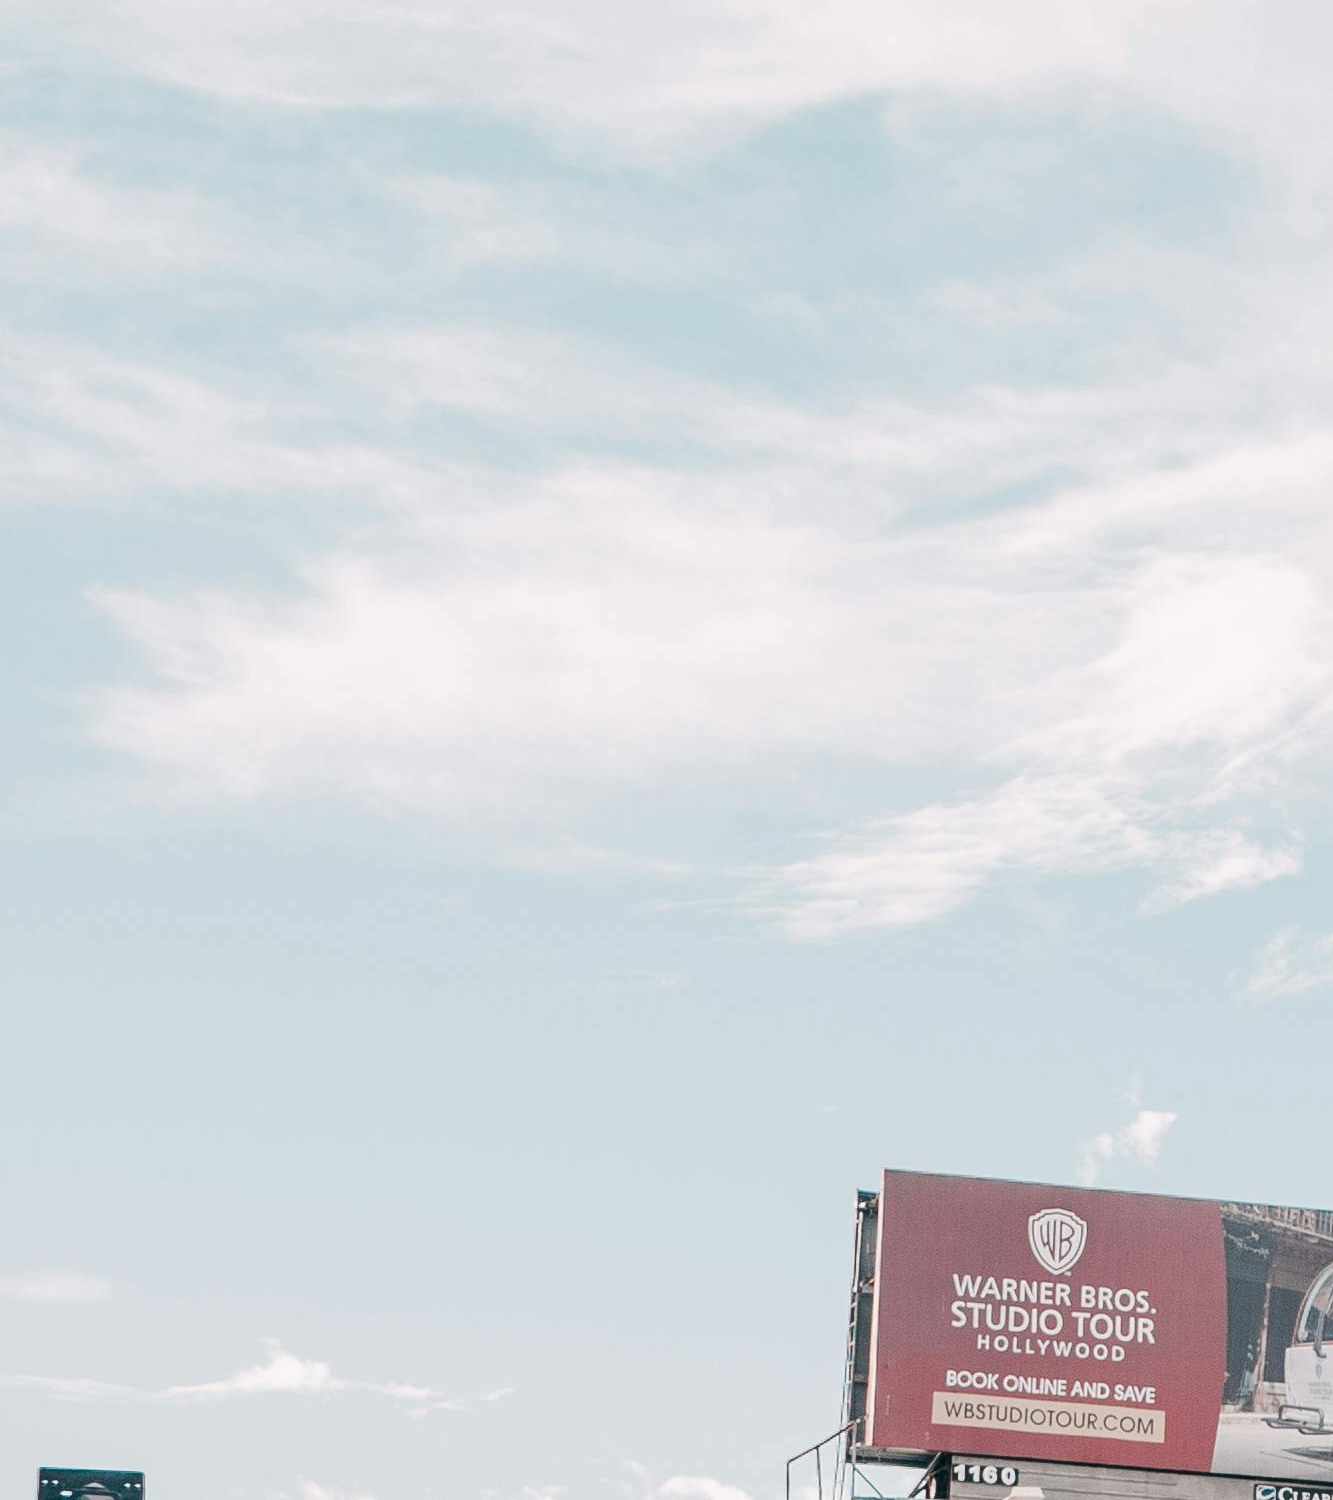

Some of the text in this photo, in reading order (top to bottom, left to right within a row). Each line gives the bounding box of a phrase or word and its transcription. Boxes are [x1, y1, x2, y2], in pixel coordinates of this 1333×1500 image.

[953, 1273, 1156, 1314] WARNER BROS.
[951, 1301, 1155, 1344] STUDIO TOUR
[977, 1334, 1125, 1361] HOLLYWOOD
[946, 1370, 1156, 1404] BOOK ONLINE AND SAVE
[945, 1401, 1154, 1435] WBSTUDIOTOUR.COM
[954, 1464, 1016, 1486] 1160
